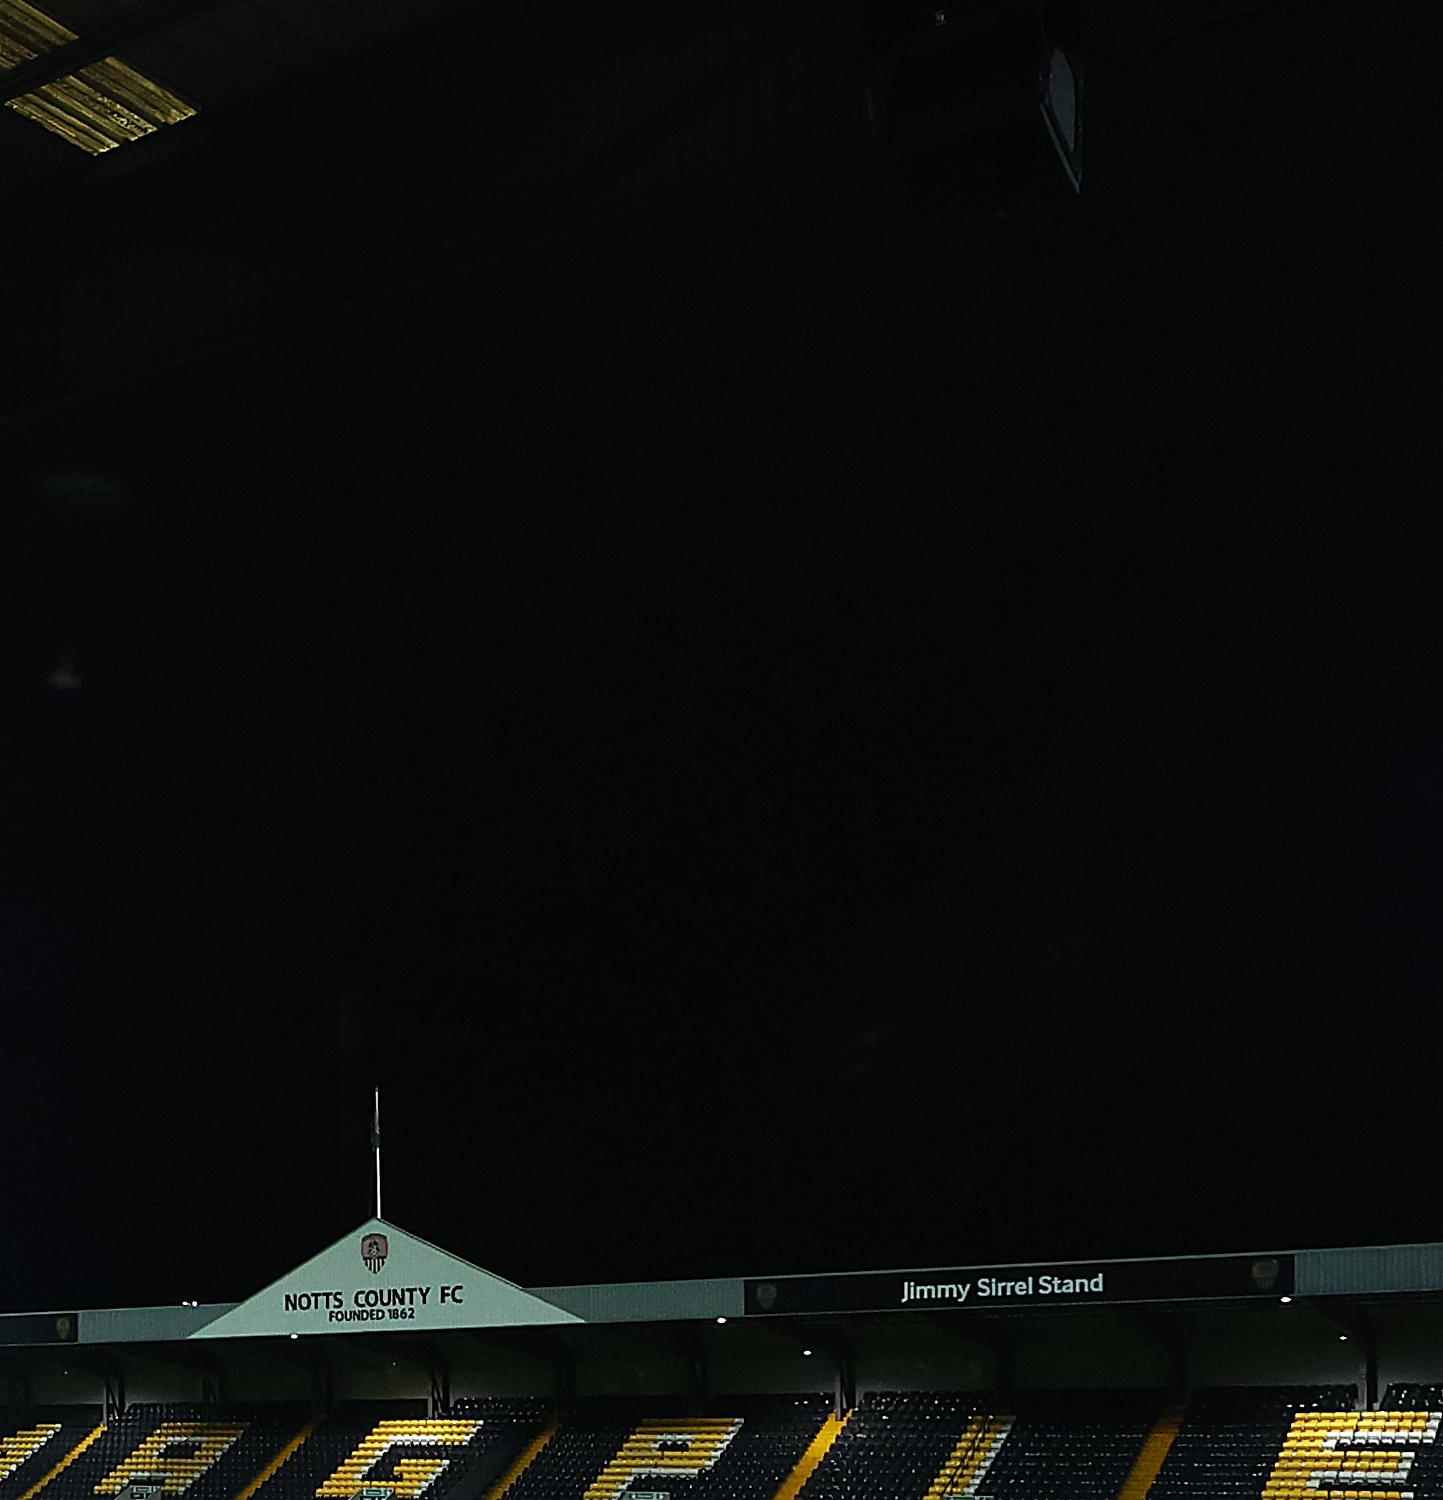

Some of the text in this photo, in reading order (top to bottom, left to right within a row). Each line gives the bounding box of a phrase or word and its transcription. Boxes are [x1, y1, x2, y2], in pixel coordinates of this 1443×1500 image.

[285, 1286, 463, 1311] NOTTS COUNTY FC
[901, 1273, 1104, 1303] Jimmy Sirrel Stand
[329, 1308, 415, 1322] FOUNDED 1862
